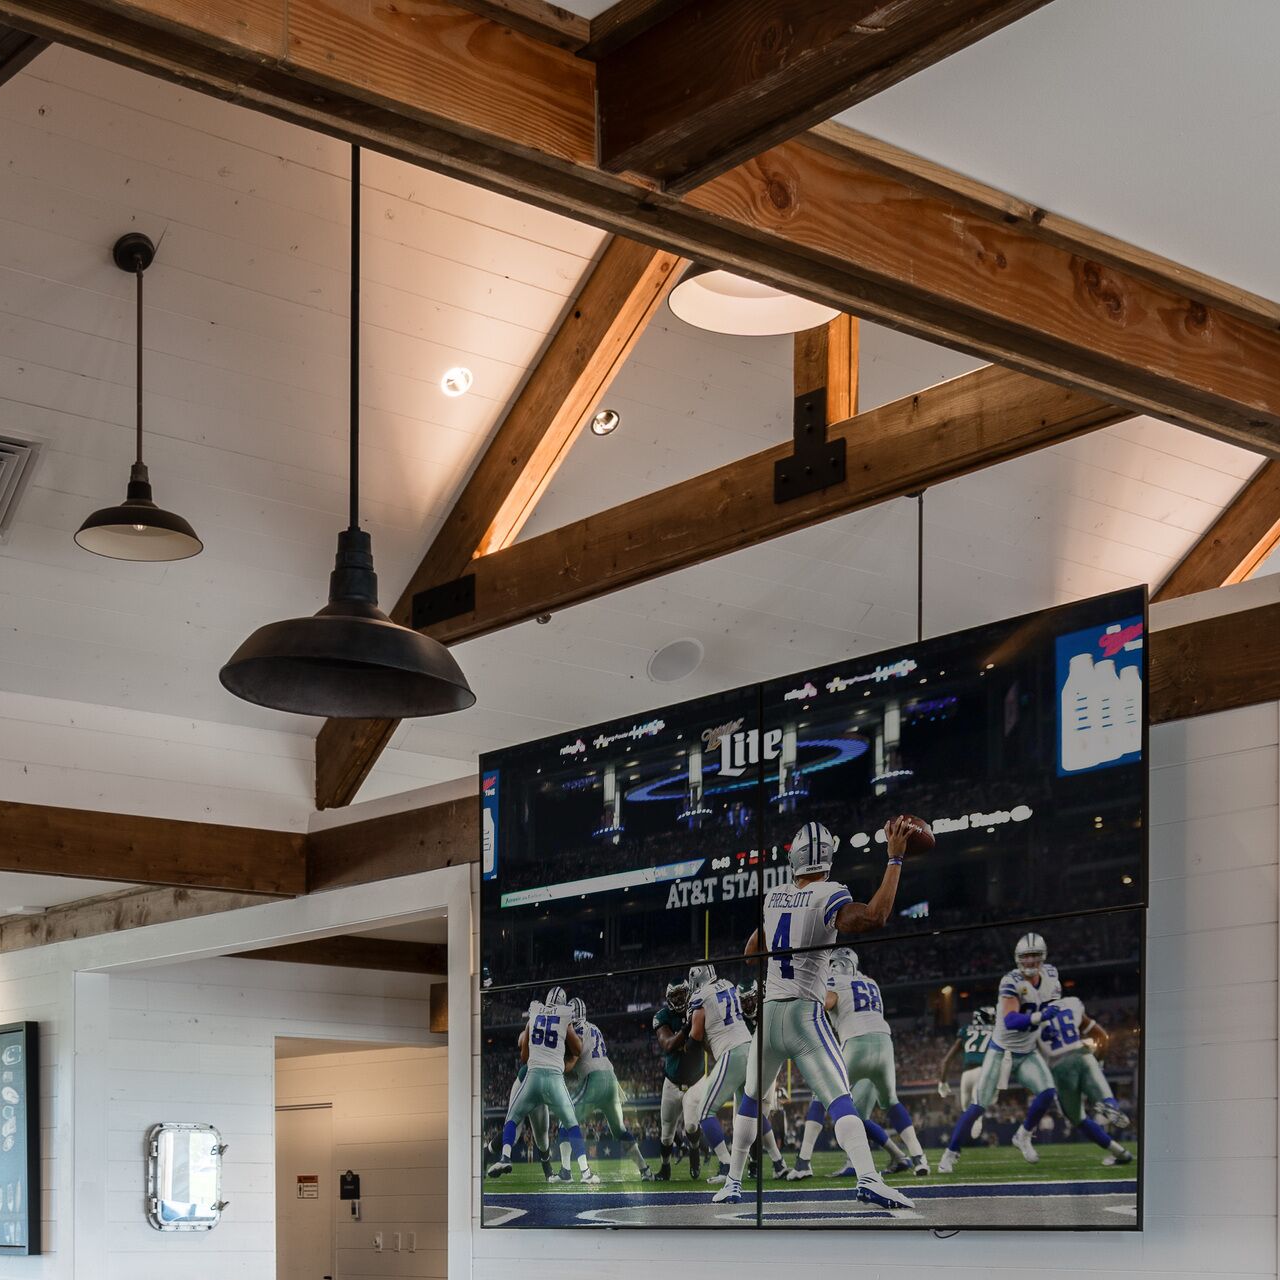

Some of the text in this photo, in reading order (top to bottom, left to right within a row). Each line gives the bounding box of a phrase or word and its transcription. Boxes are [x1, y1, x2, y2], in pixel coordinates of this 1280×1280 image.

[665, 877, 718, 910] AT&T
[722, 865, 793, 901] STADI
[768, 891, 814, 908] PRESCOTT
[772, 913, 794, 979] 4
[964, 1029, 993, 1053] 27
